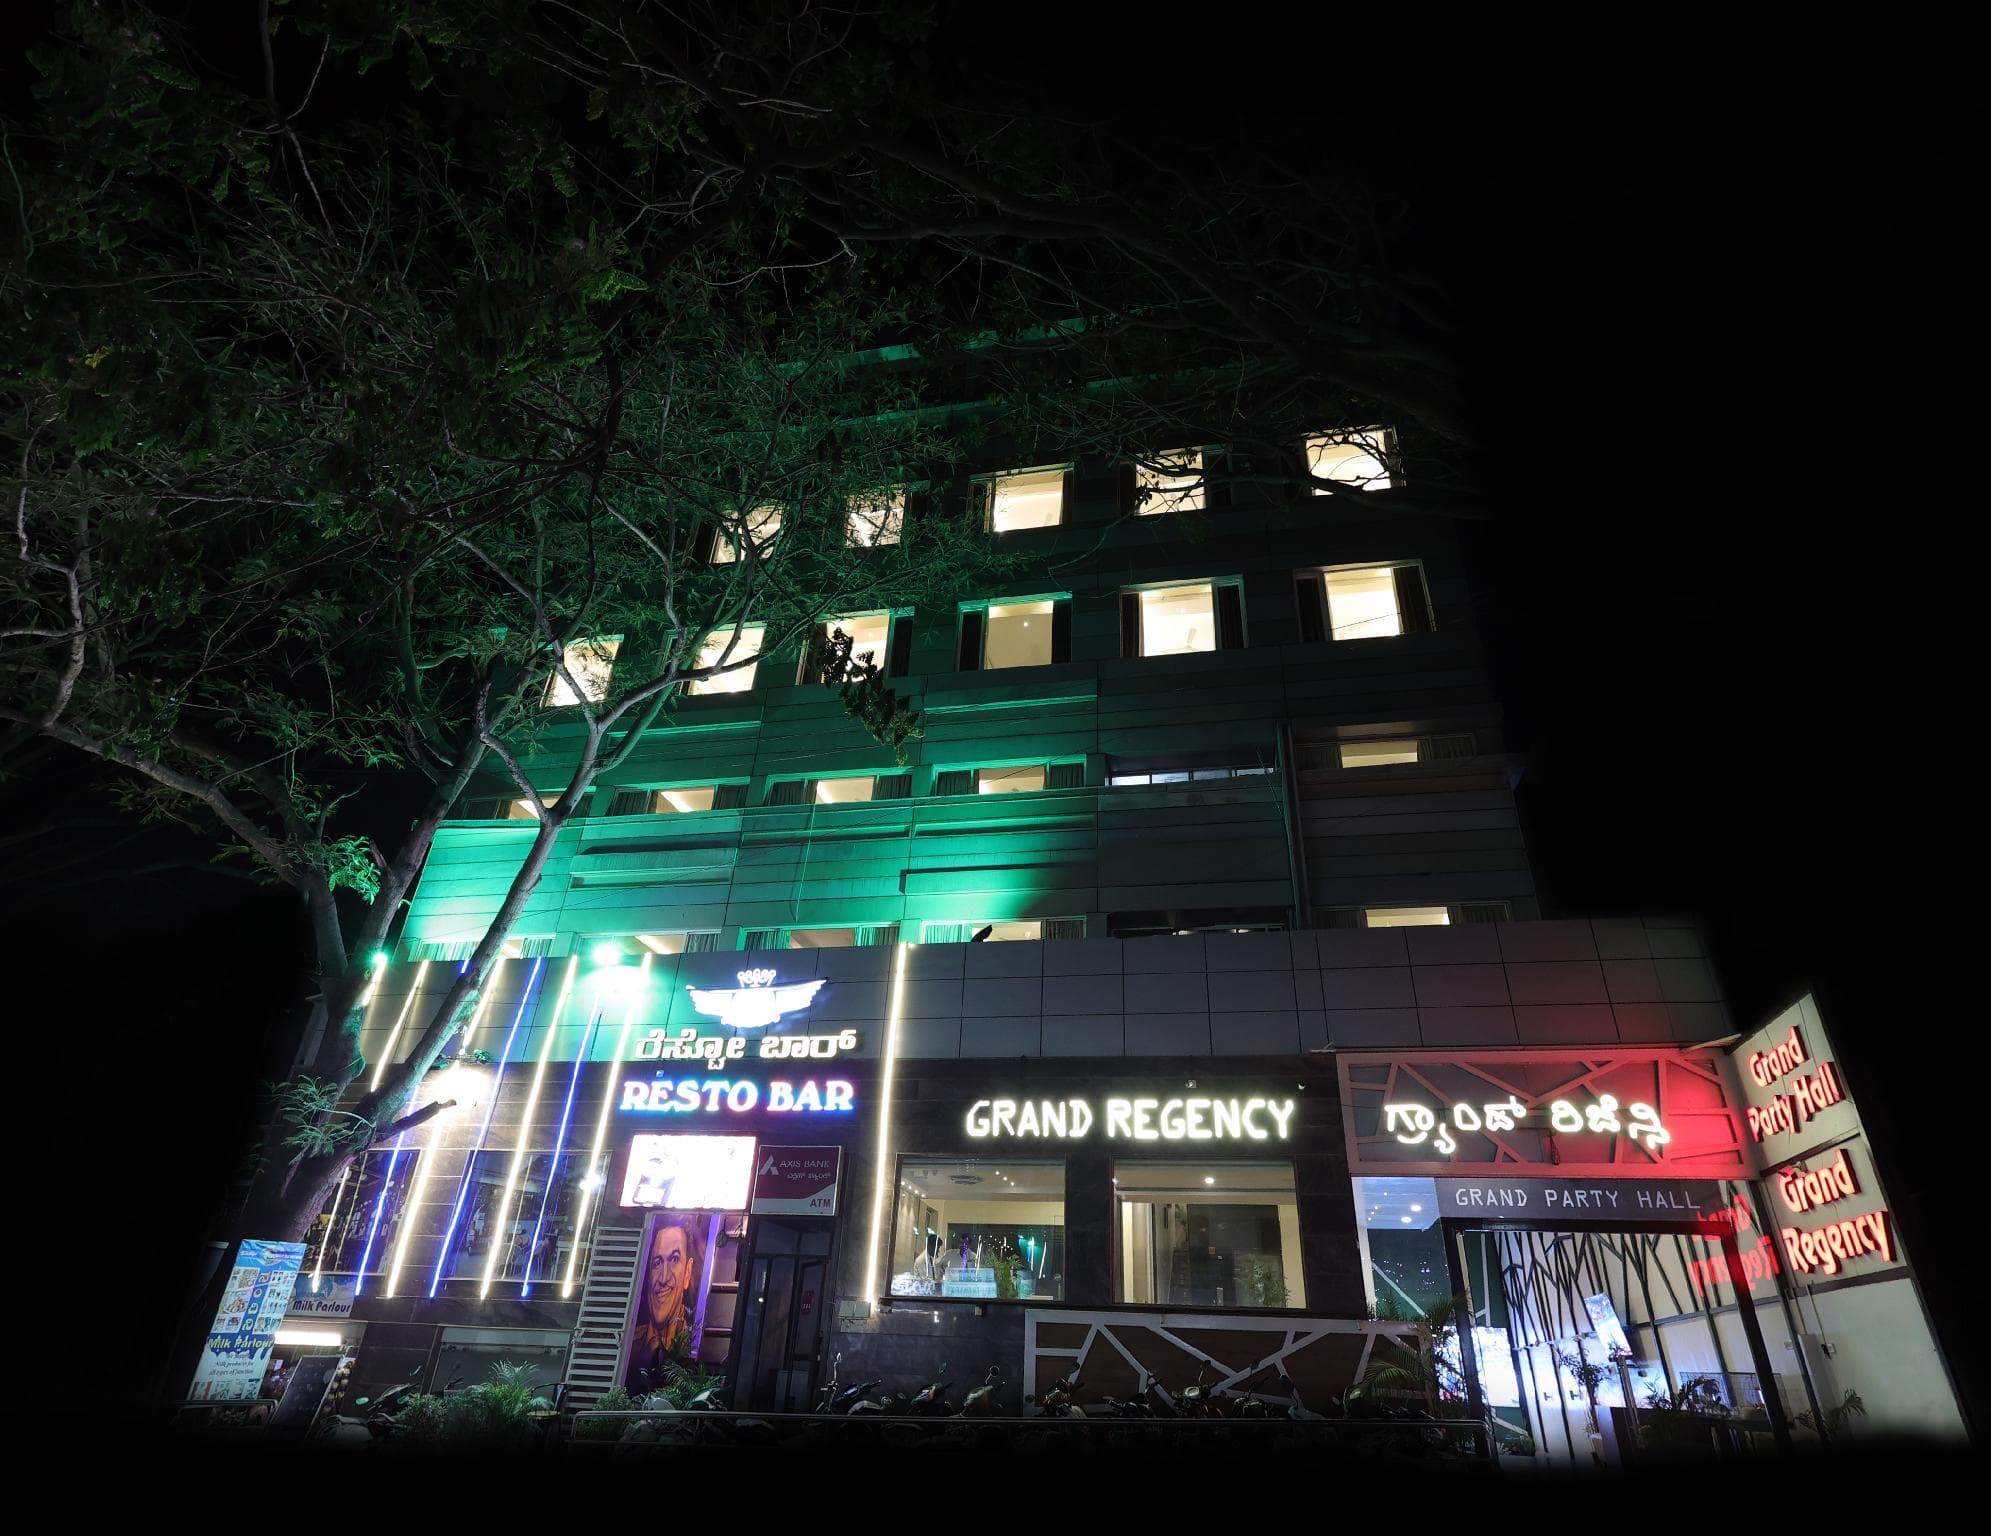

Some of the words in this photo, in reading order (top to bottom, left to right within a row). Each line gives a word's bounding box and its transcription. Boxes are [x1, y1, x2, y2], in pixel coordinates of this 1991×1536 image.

[759, 1029, 857, 1058] ಬಾರ್
[1748, 1024, 1808, 1088] Grand
[619, 1079, 759, 1112] RESTO
[766, 1080, 855, 1111] BAR
[1746, 1094, 1801, 1142] Party
[1792, 1061, 1845, 1121] Hall
[966, 1099, 1093, 1138] GRAND
[1106, 1098, 1295, 1140] REGENCY
[779, 1160, 802, 1168] AXIS
[804, 1160, 830, 1168] BANK
[1779, 1148, 1860, 1213] Grand
[810, 1199, 831, 1208] ATM
[1455, 1188, 1528, 1207] GRAND
[1545, 1189, 1619, 1209] PARTY
[1639, 1190, 1701, 1210] HALL
[1781, 1210, 1897, 1276] Regency
[292, 1300, 313, 1311] Milk
[316, 1301, 351, 1313] Parlour
[207, 1337, 231, 1349] Milk
[234, 1337, 274, 1349] Parlour
